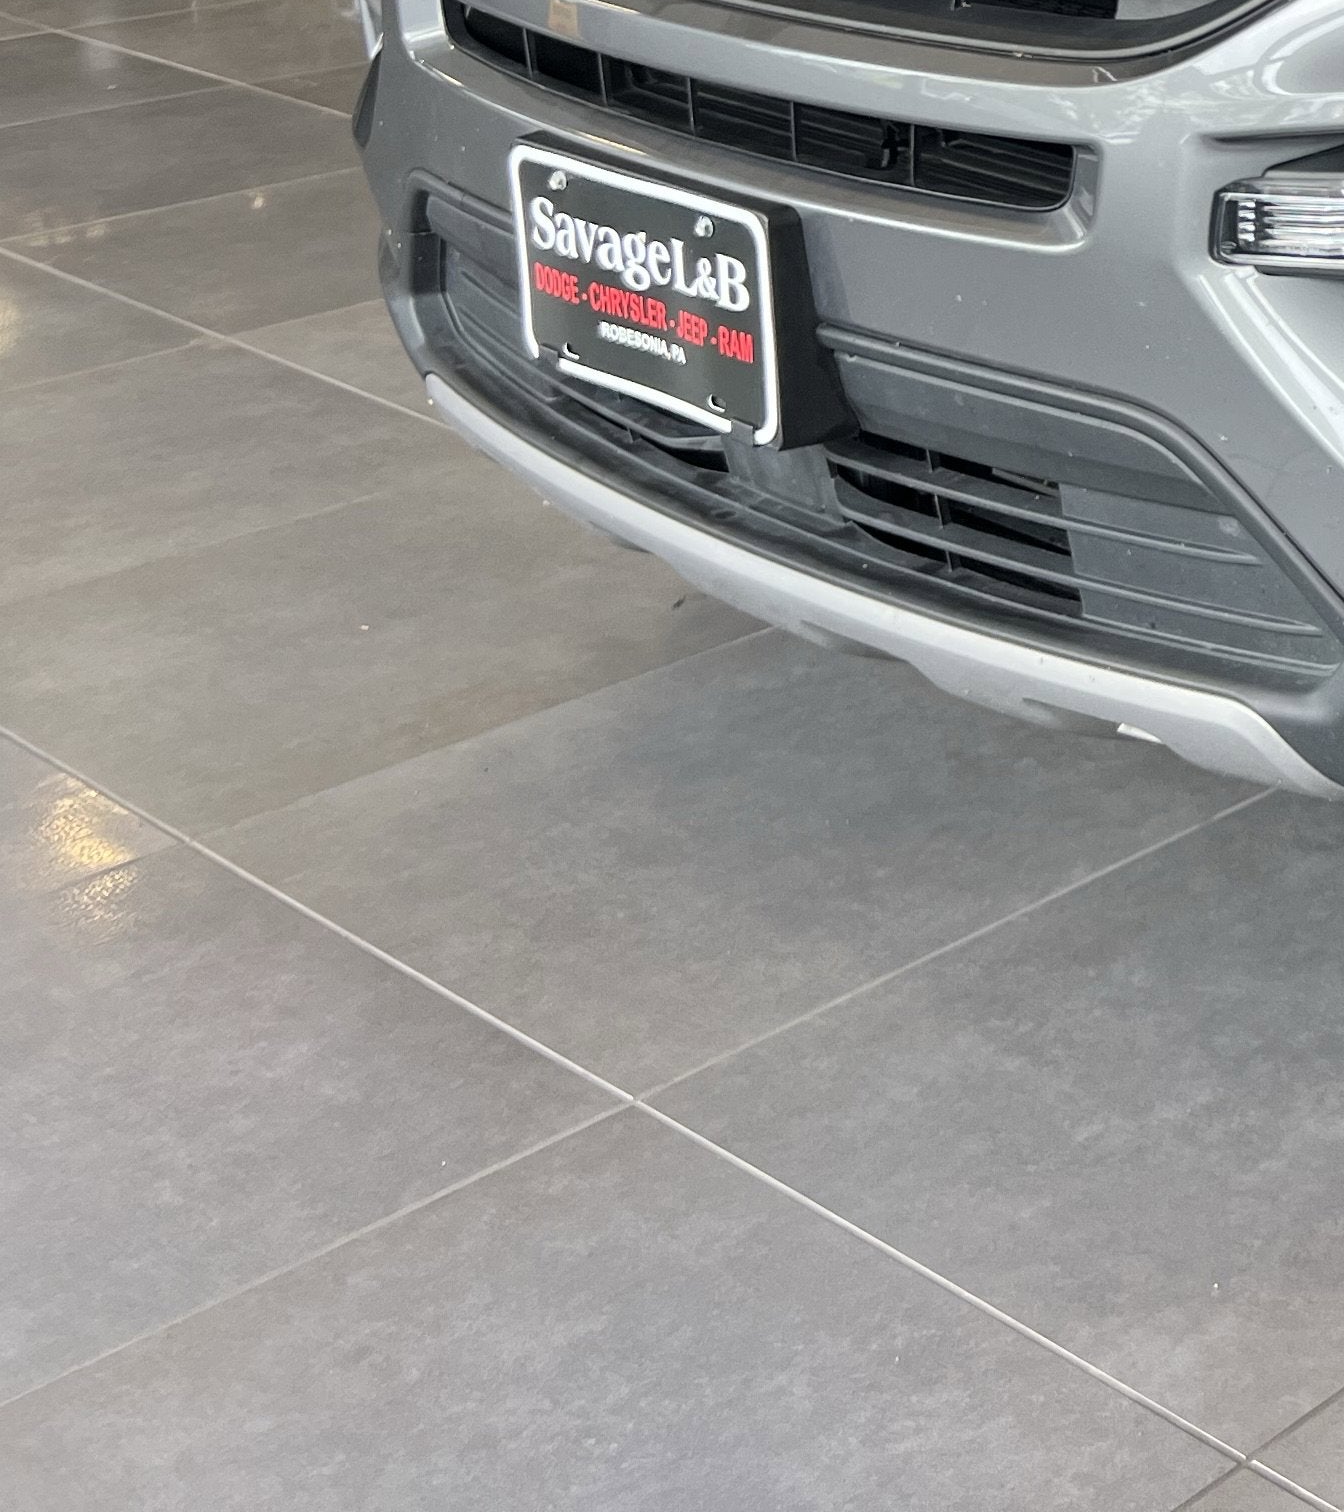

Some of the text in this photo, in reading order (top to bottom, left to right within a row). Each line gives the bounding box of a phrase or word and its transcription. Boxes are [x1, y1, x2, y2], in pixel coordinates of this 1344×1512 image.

[533, 261, 754, 364] DODGE CHRYSLER JEEP RAM
